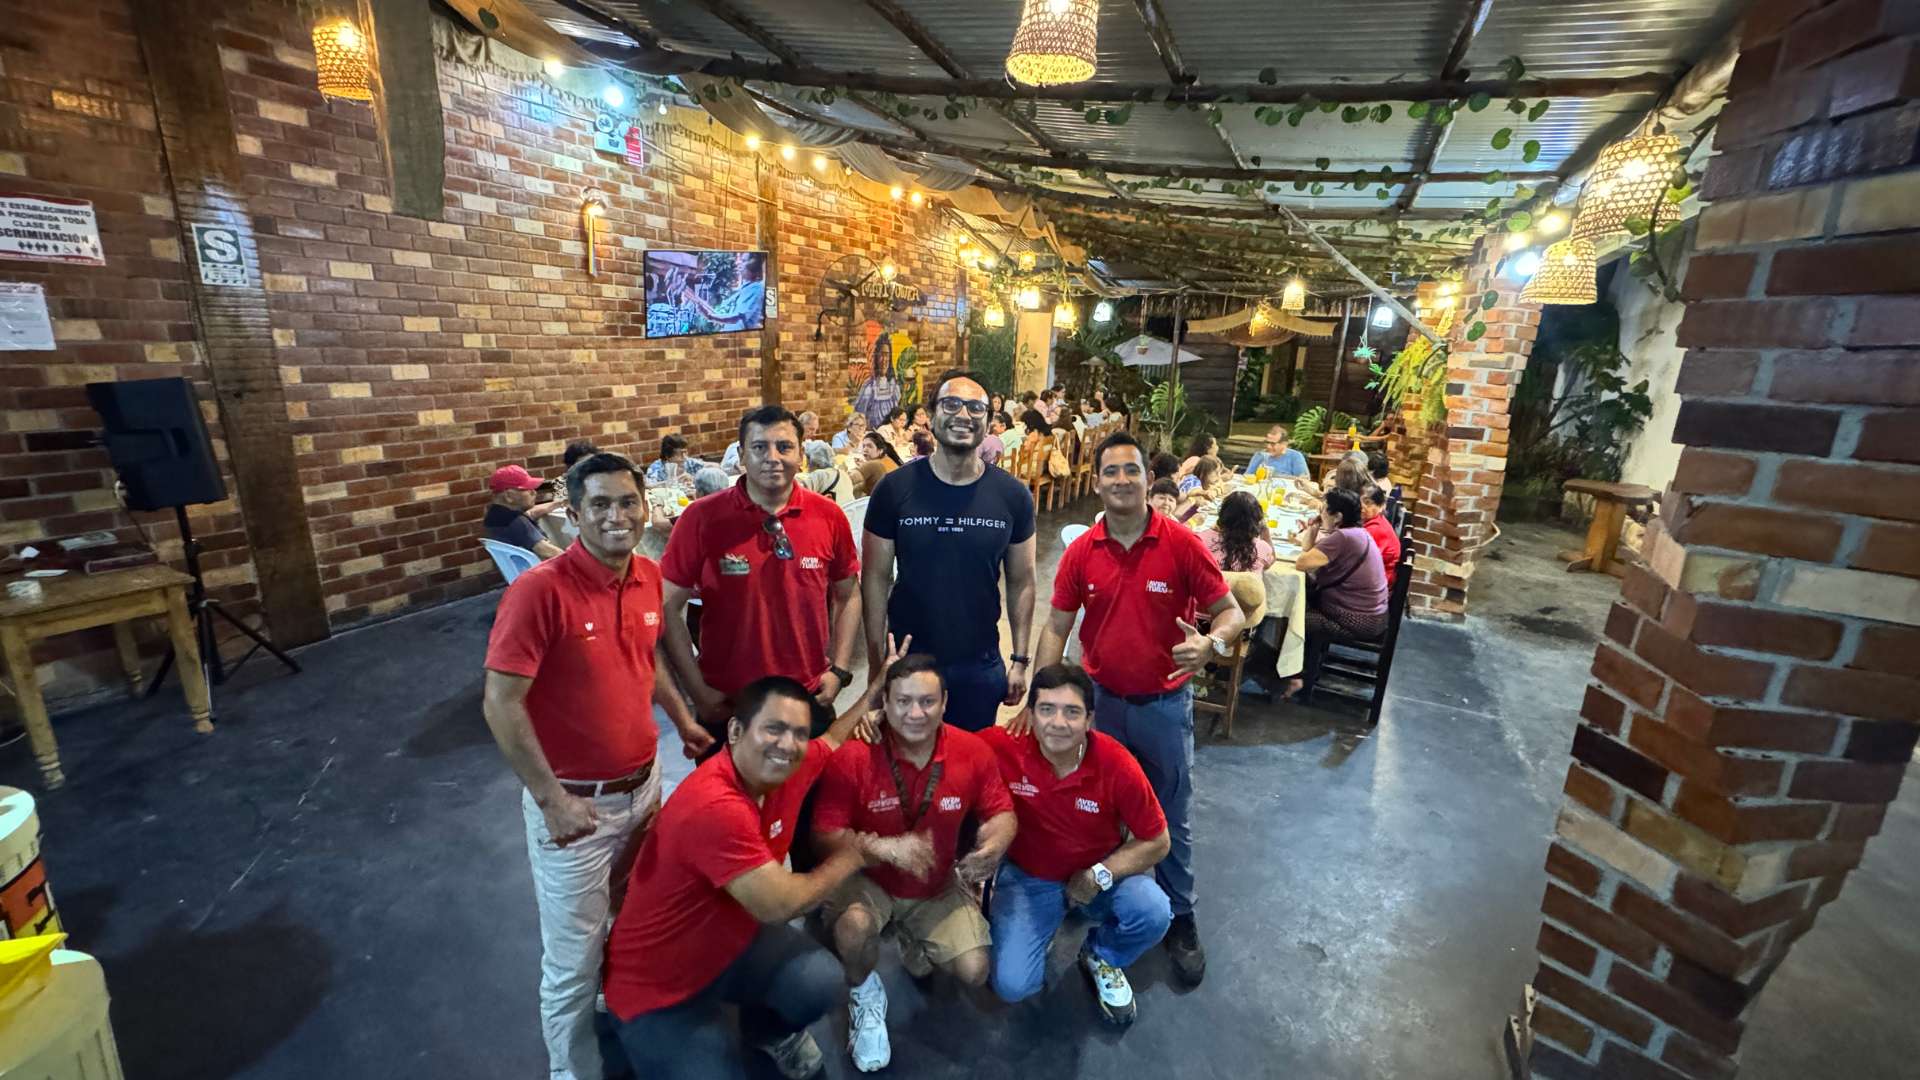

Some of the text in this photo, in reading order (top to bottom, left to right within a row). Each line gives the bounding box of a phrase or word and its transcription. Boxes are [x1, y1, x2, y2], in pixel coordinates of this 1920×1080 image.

[9, 202, 91, 217] ESTABLECIMIENTO
[8, 211, 60, 221] PROHIBIDA
[62, 216, 87, 225] TODA
[12, 219, 61, 231] CLASE DE
[203, 230, 238, 262] S
[766, 289, 775, 306] S
[899, 517, 1006, 529] TOMMY HILFIGER
